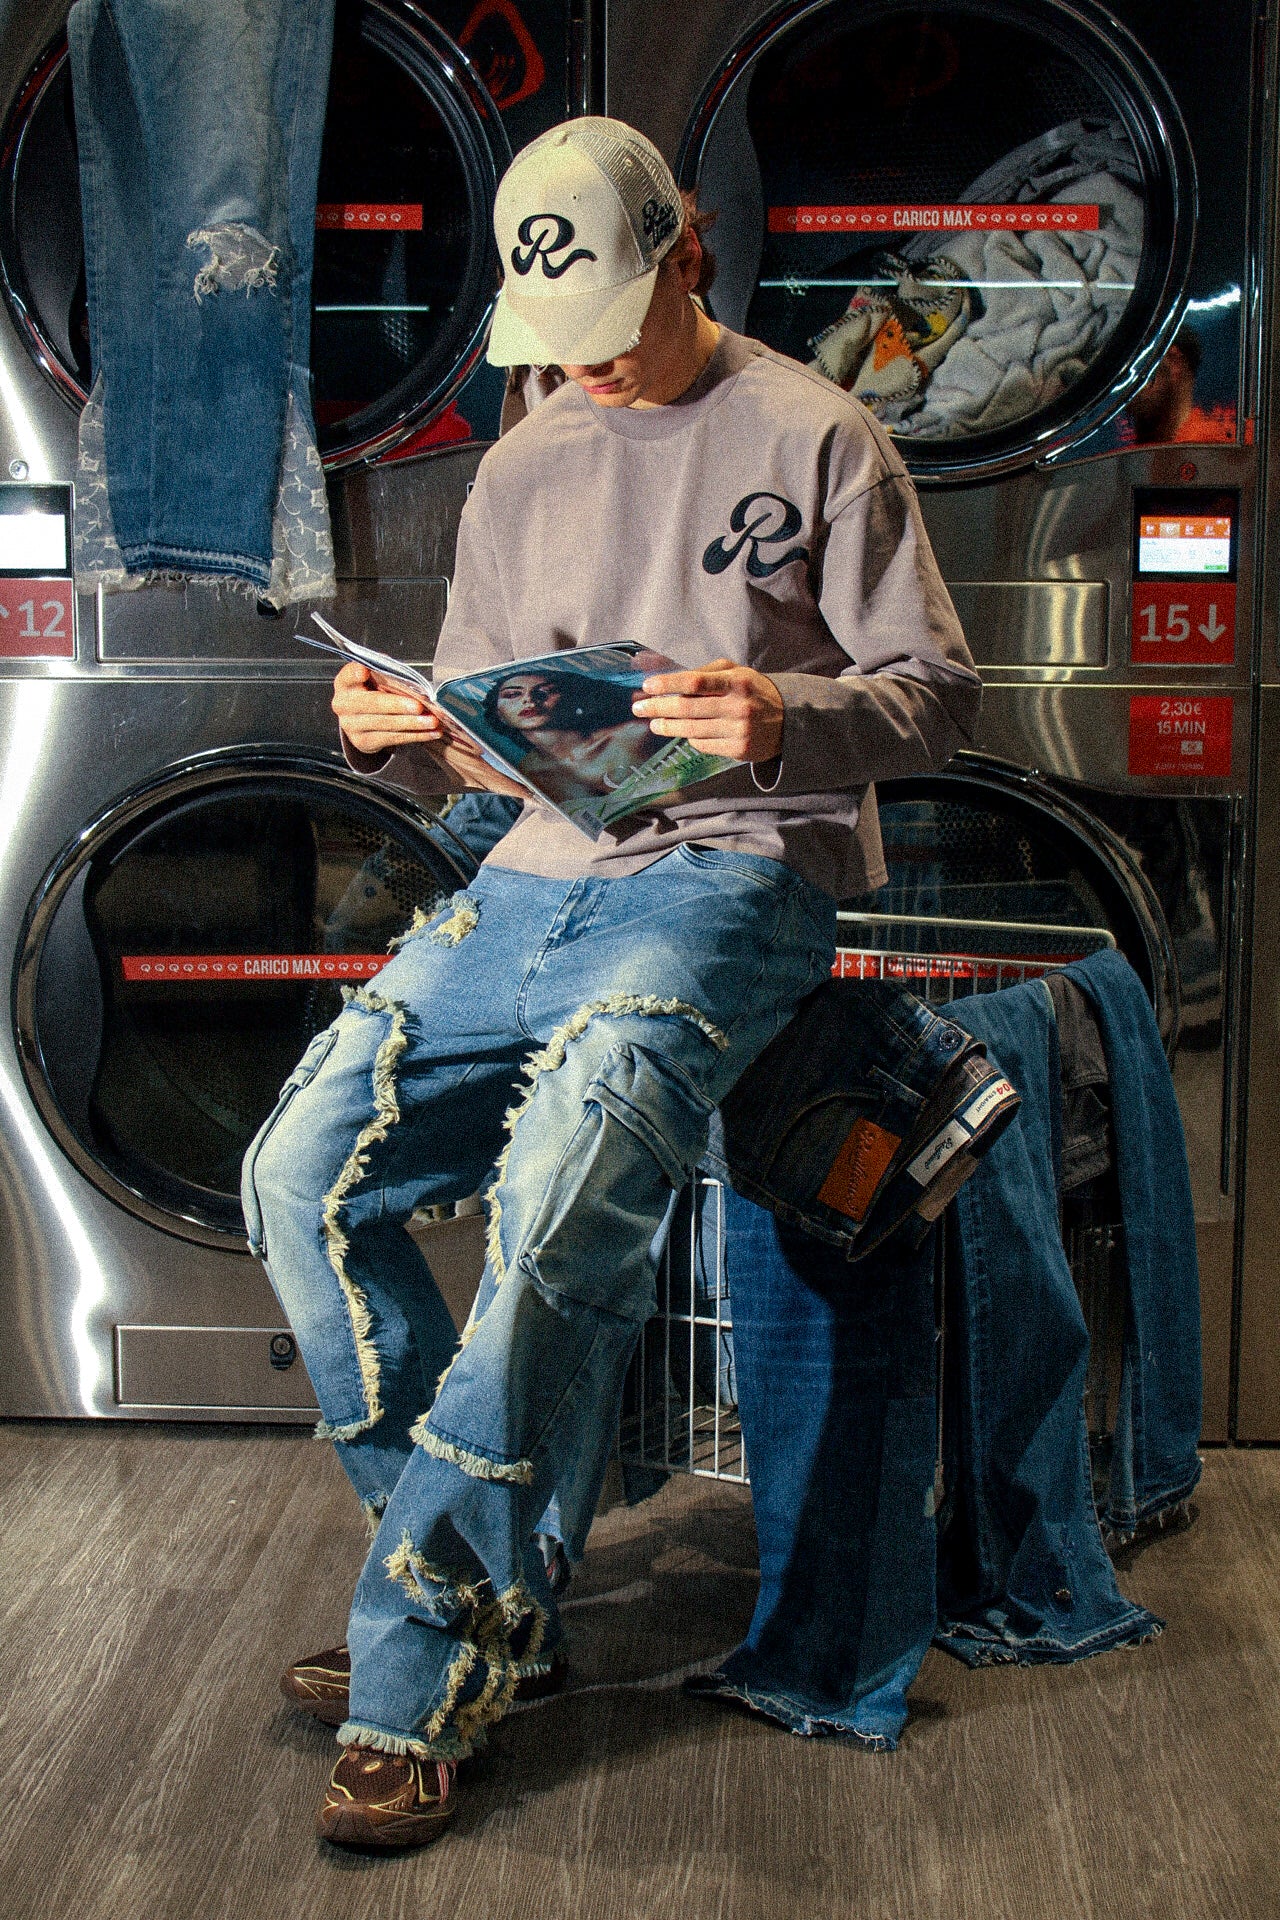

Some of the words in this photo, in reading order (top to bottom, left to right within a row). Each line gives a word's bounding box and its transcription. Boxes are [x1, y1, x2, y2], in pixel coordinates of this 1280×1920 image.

[893, 210, 940, 227] CARICO
[943, 210, 973, 227] MAX
[511, 213, 598, 279] R
[701, 491, 810, 579] R
[18, 600, 66, 637] 12
[1140, 603, 1190, 642] 15
[1160, 701, 1202, 717] 2,30€
[1156, 721, 1171, 735] 15
[1174, 720, 1206, 735] MIN
[244, 959, 289, 975] CARICO
[292, 959, 321, 974] MAX
[996, 1082, 1013, 1095] 04
